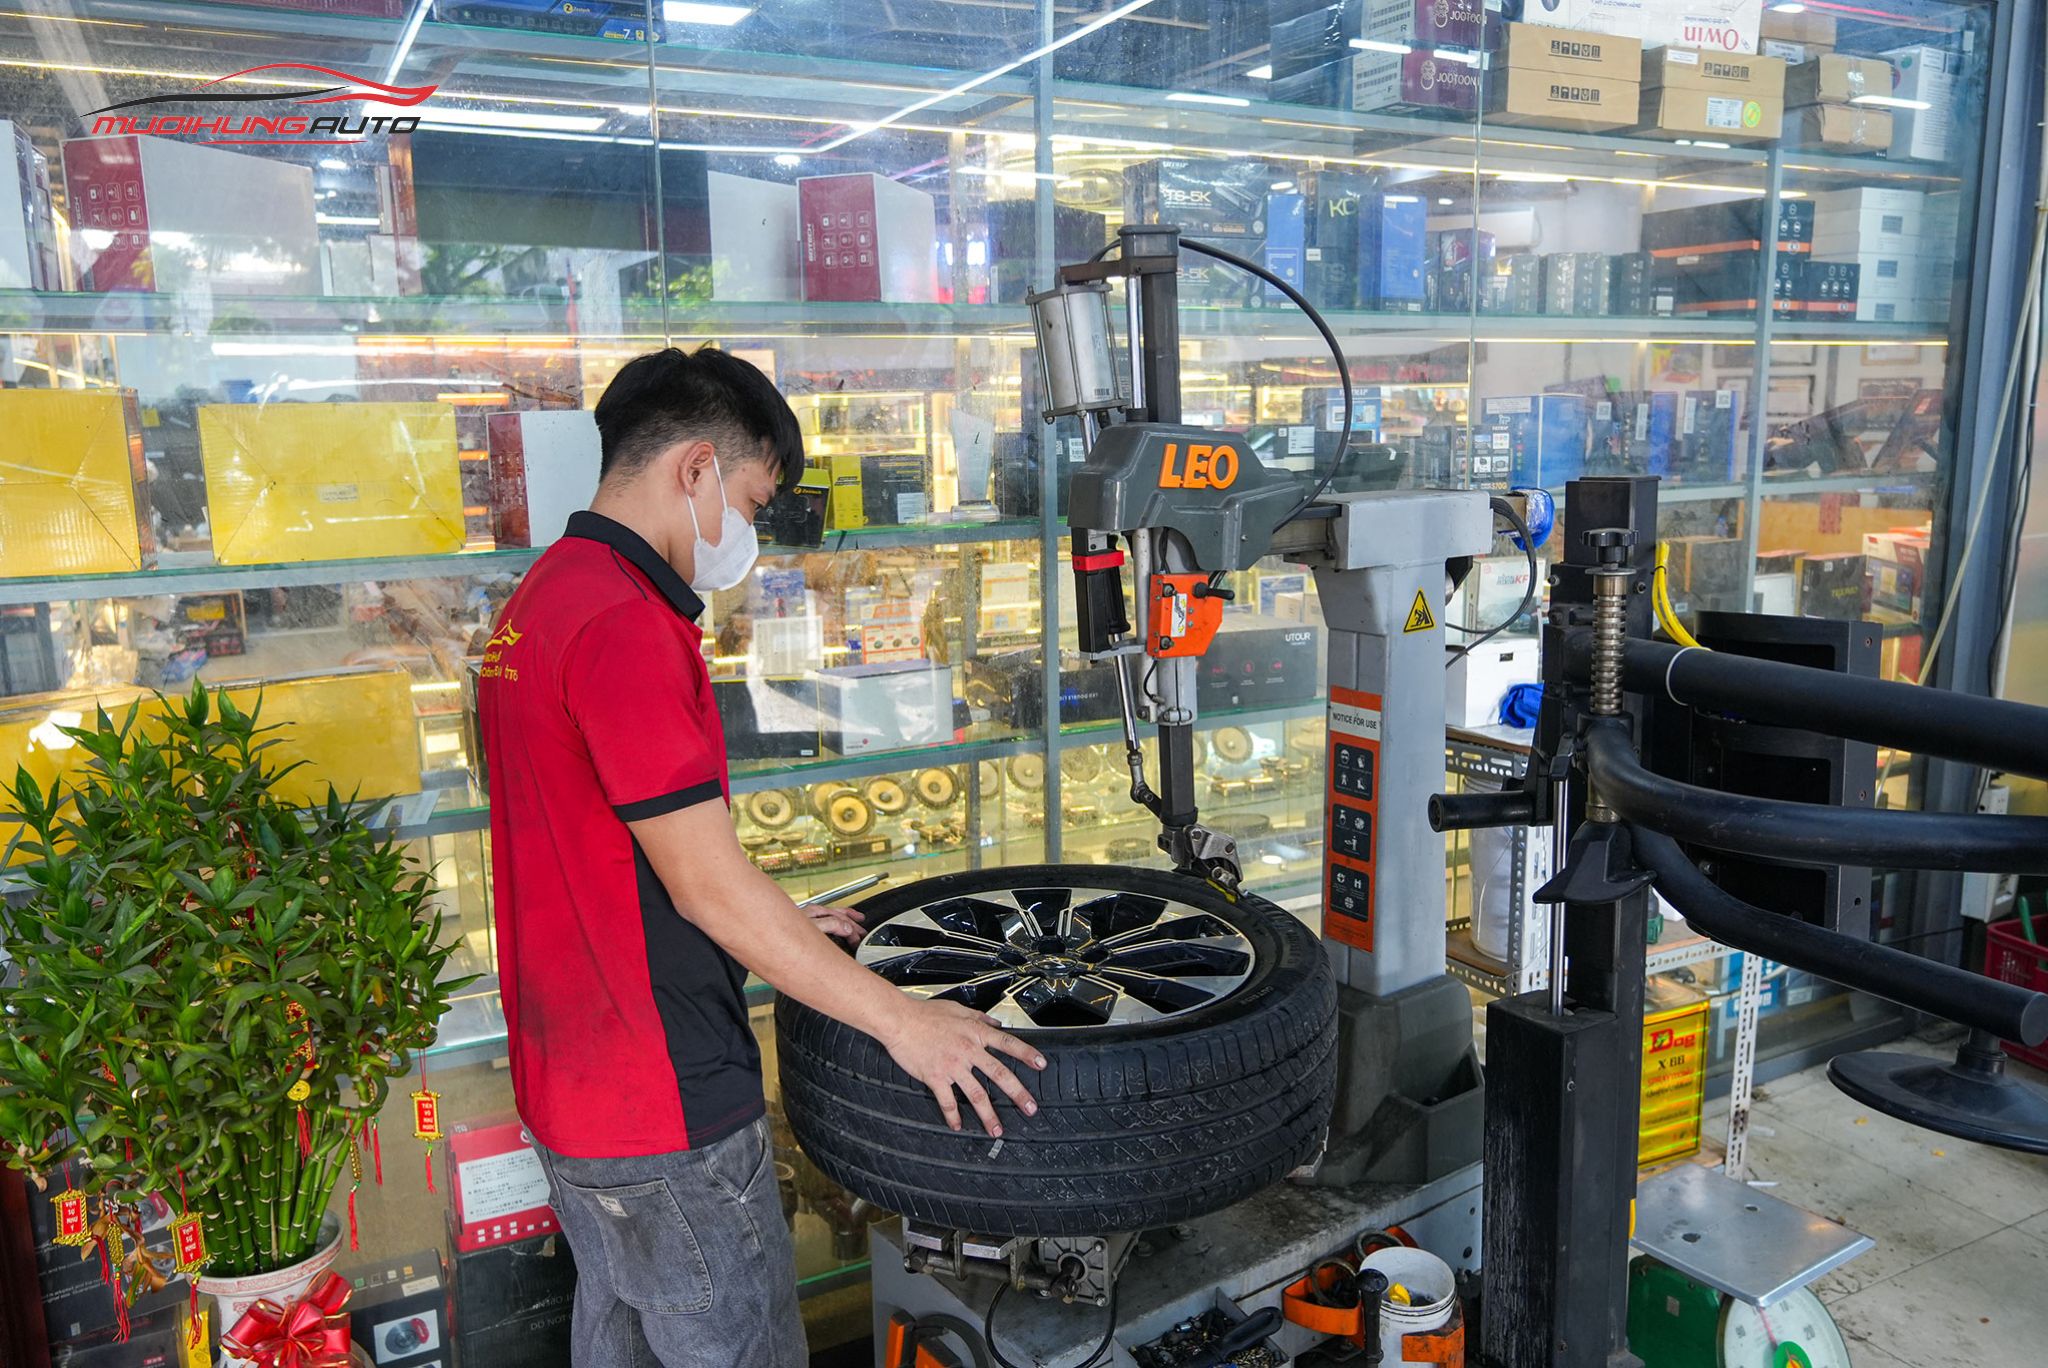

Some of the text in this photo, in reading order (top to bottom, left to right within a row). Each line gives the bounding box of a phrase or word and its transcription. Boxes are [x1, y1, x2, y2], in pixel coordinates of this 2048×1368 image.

[1684, 26, 1739, 50] Owin
[1159, 443, 1239, 489] LEO
[1285, 631, 1311, 642] UTOUR
[1333, 712, 1377, 729] NOTICE FOR USE
